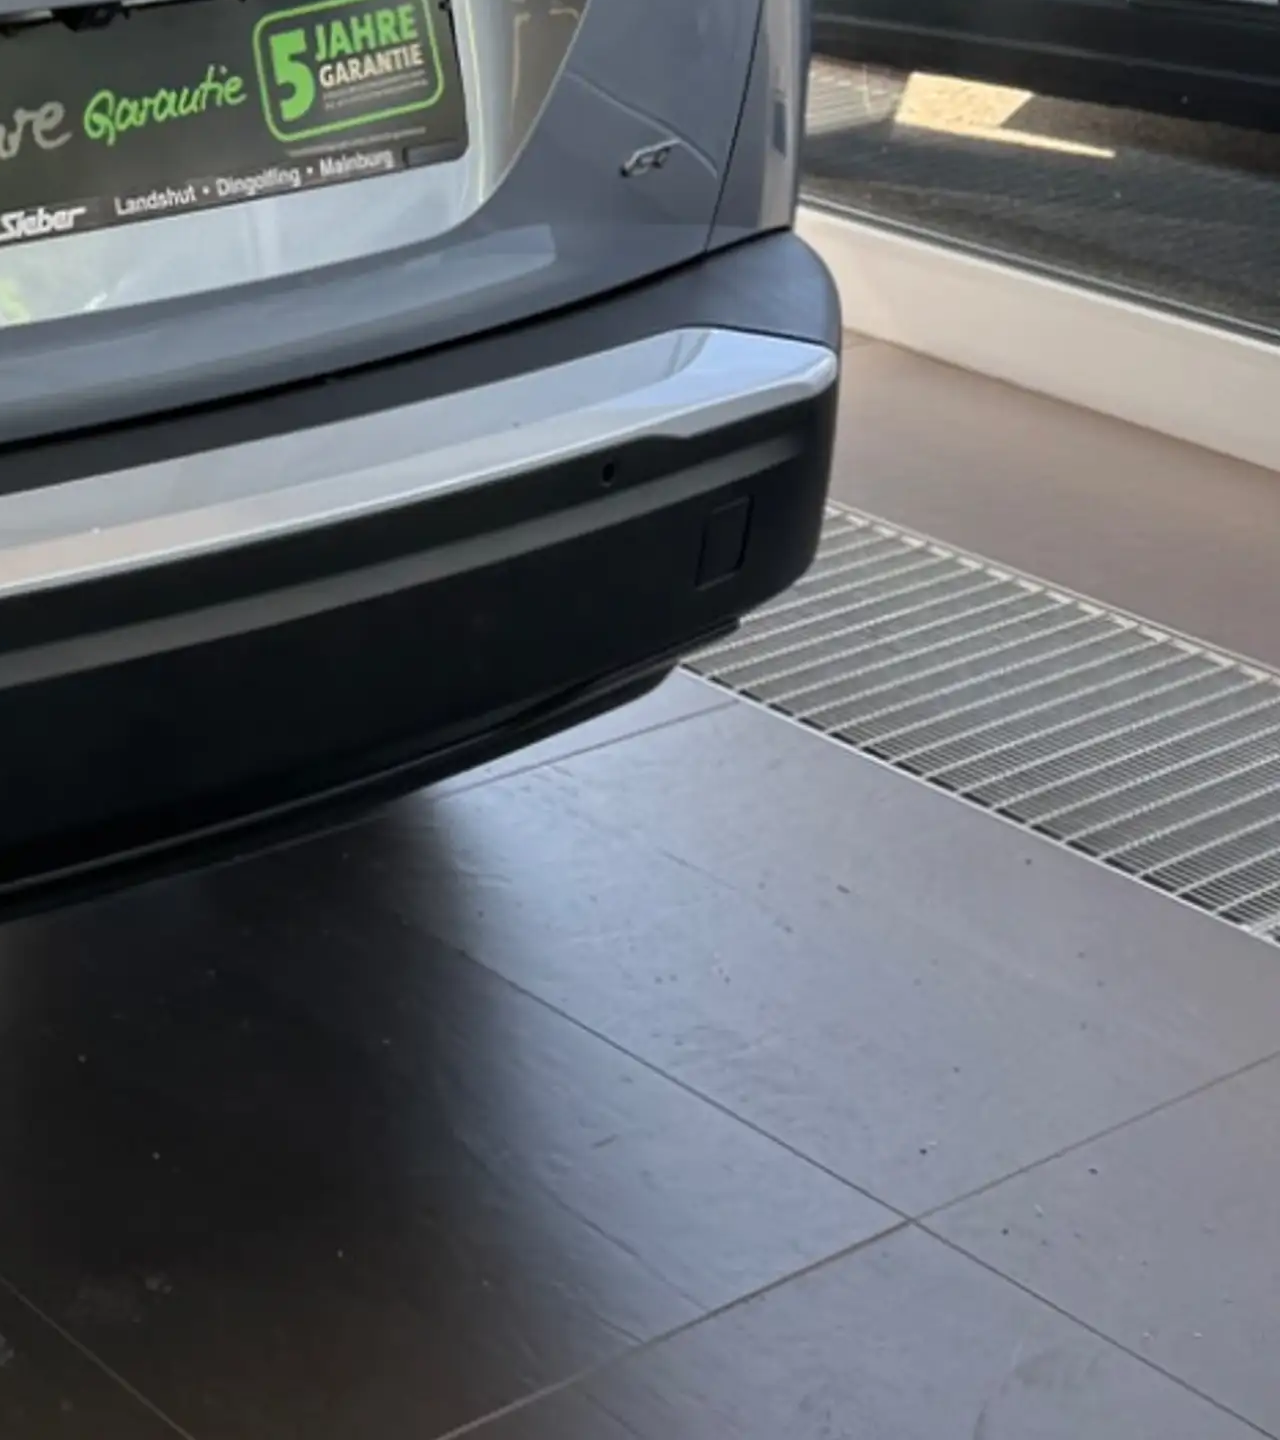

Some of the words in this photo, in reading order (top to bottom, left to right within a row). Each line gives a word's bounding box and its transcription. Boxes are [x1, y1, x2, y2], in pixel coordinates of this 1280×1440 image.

[314, 4, 418, 61] JAHRE
[319, 44, 424, 88] GARANTIE
[84, 65, 247, 147] Garantie
[269, 28, 315, 122] 5
[113, 184, 197, 216] Landshut
[215, 165, 301, 197] Dingolfing
[319, 148, 395, 178] Mainburg
